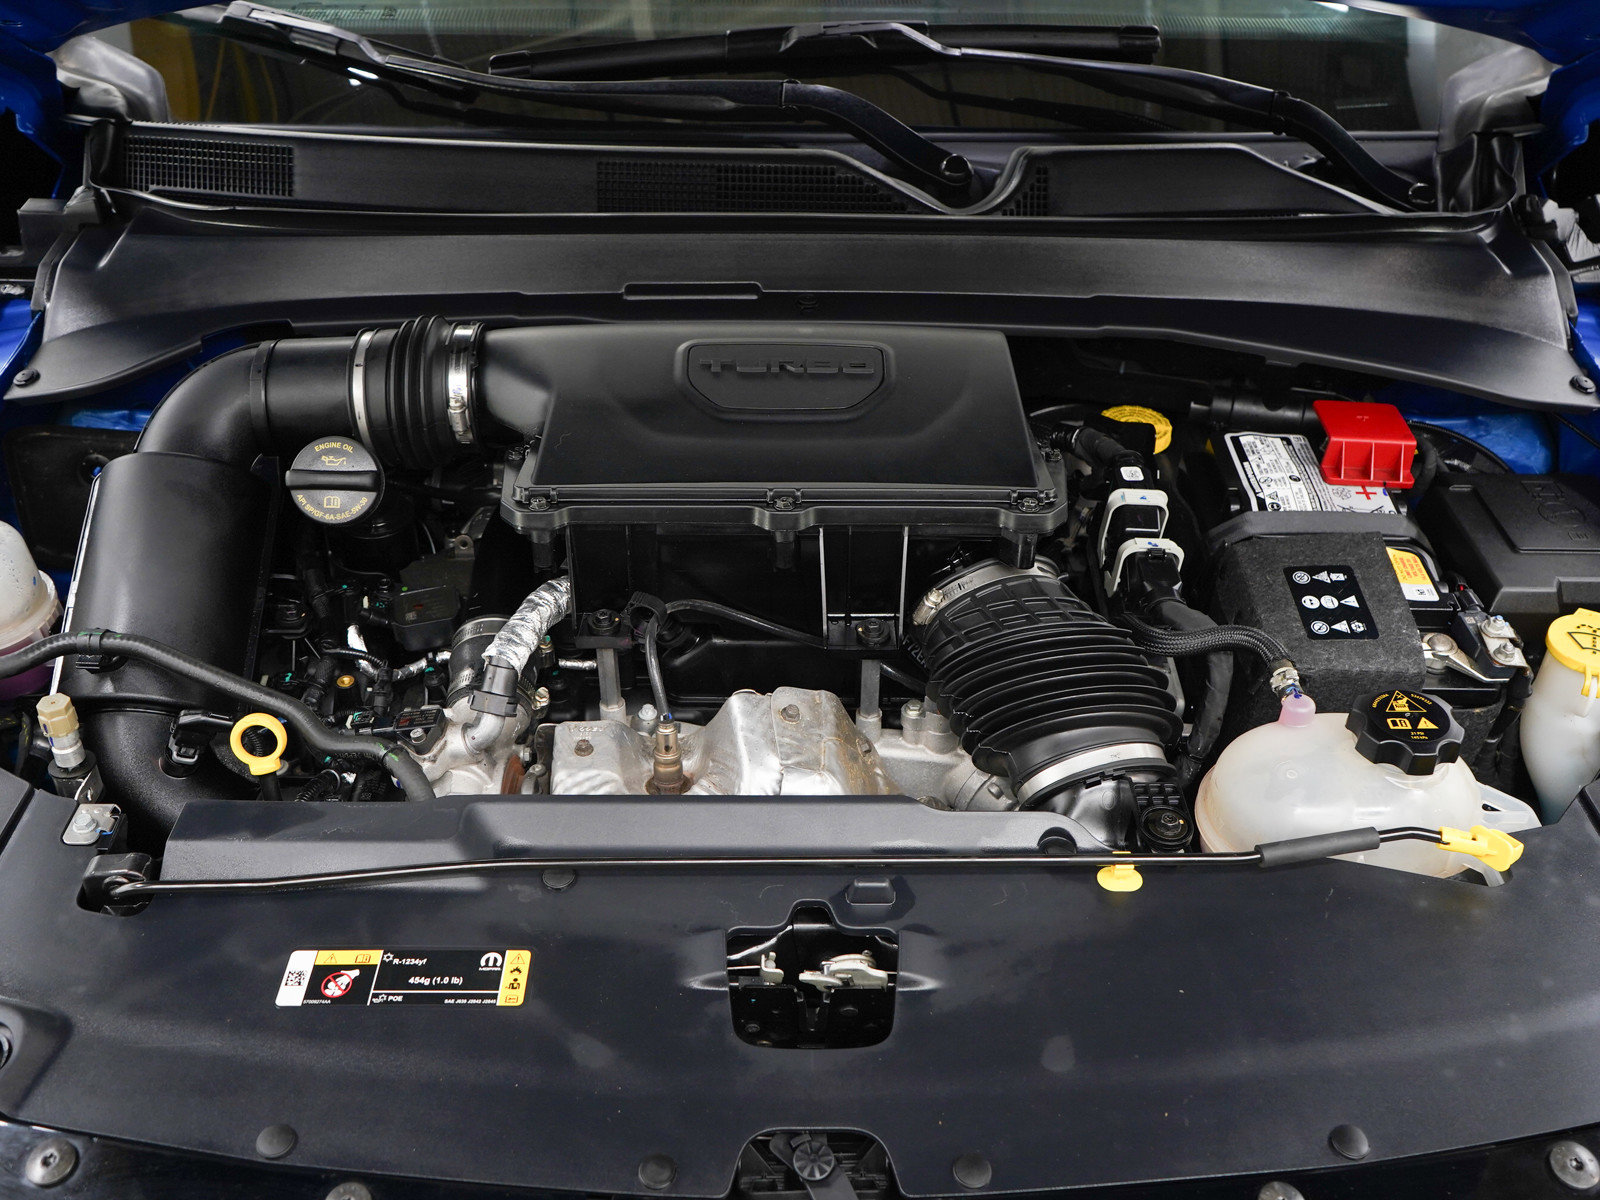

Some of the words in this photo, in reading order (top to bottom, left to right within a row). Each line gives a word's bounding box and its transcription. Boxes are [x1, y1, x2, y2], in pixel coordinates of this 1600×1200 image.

[699, 358, 875, 374] TURBO
[314, 442, 341, 452] ENGINE
[342, 443, 355, 453] OIL
[297, 494, 306, 505] API
[392, 958, 428, 966] R-1234yf
[408, 976, 430, 985] 454g
[432, 976, 449, 985] (1.0
[450, 976, 464, 985] lb)
